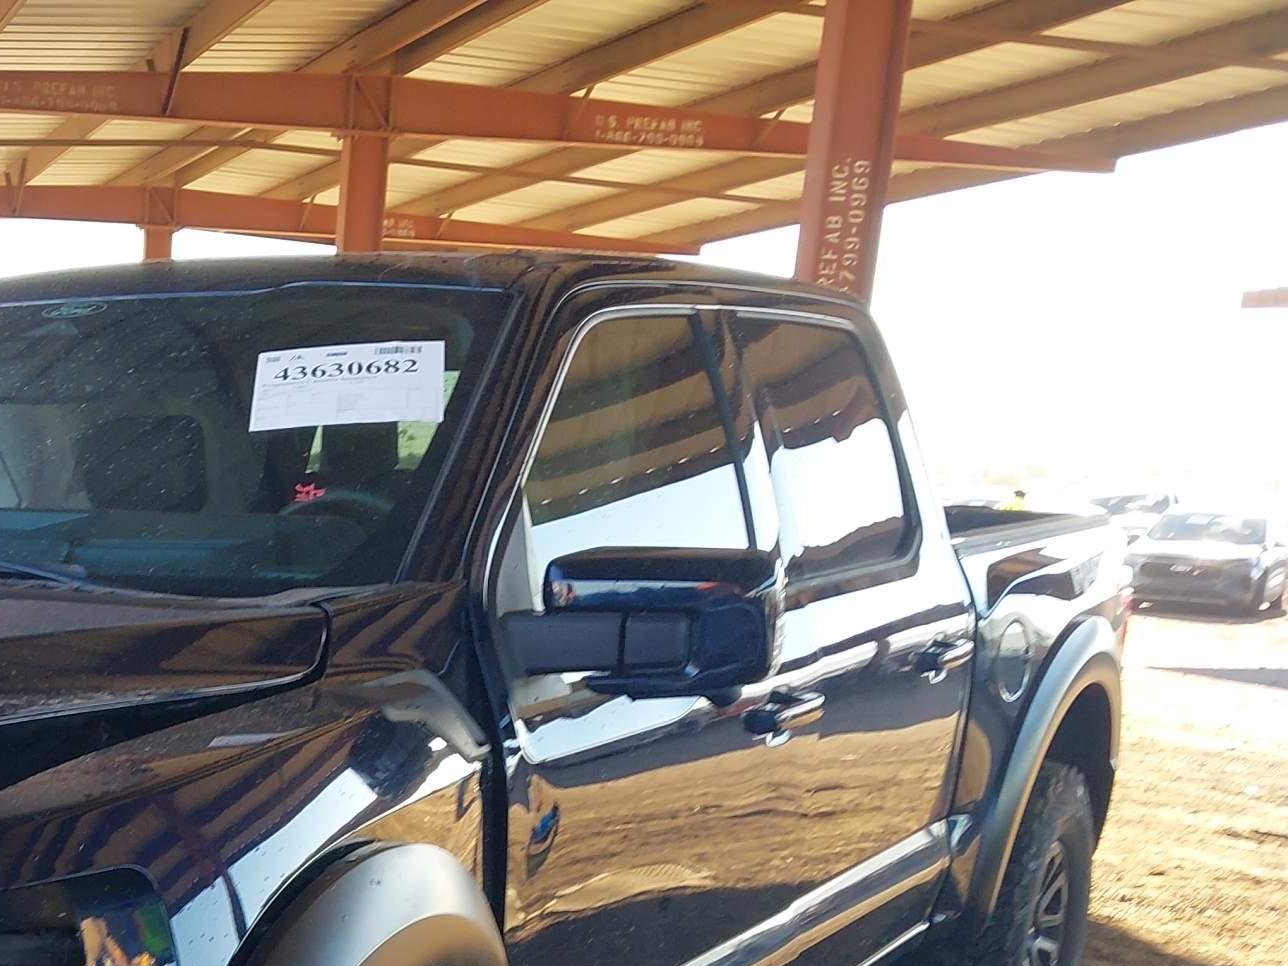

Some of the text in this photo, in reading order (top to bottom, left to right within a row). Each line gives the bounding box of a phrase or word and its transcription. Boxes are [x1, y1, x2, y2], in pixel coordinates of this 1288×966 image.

[816, 157, 852, 288] REFAB INC.
[839, 160, 872, 293] -799-0969
[273, 358, 419, 382] 43630682
